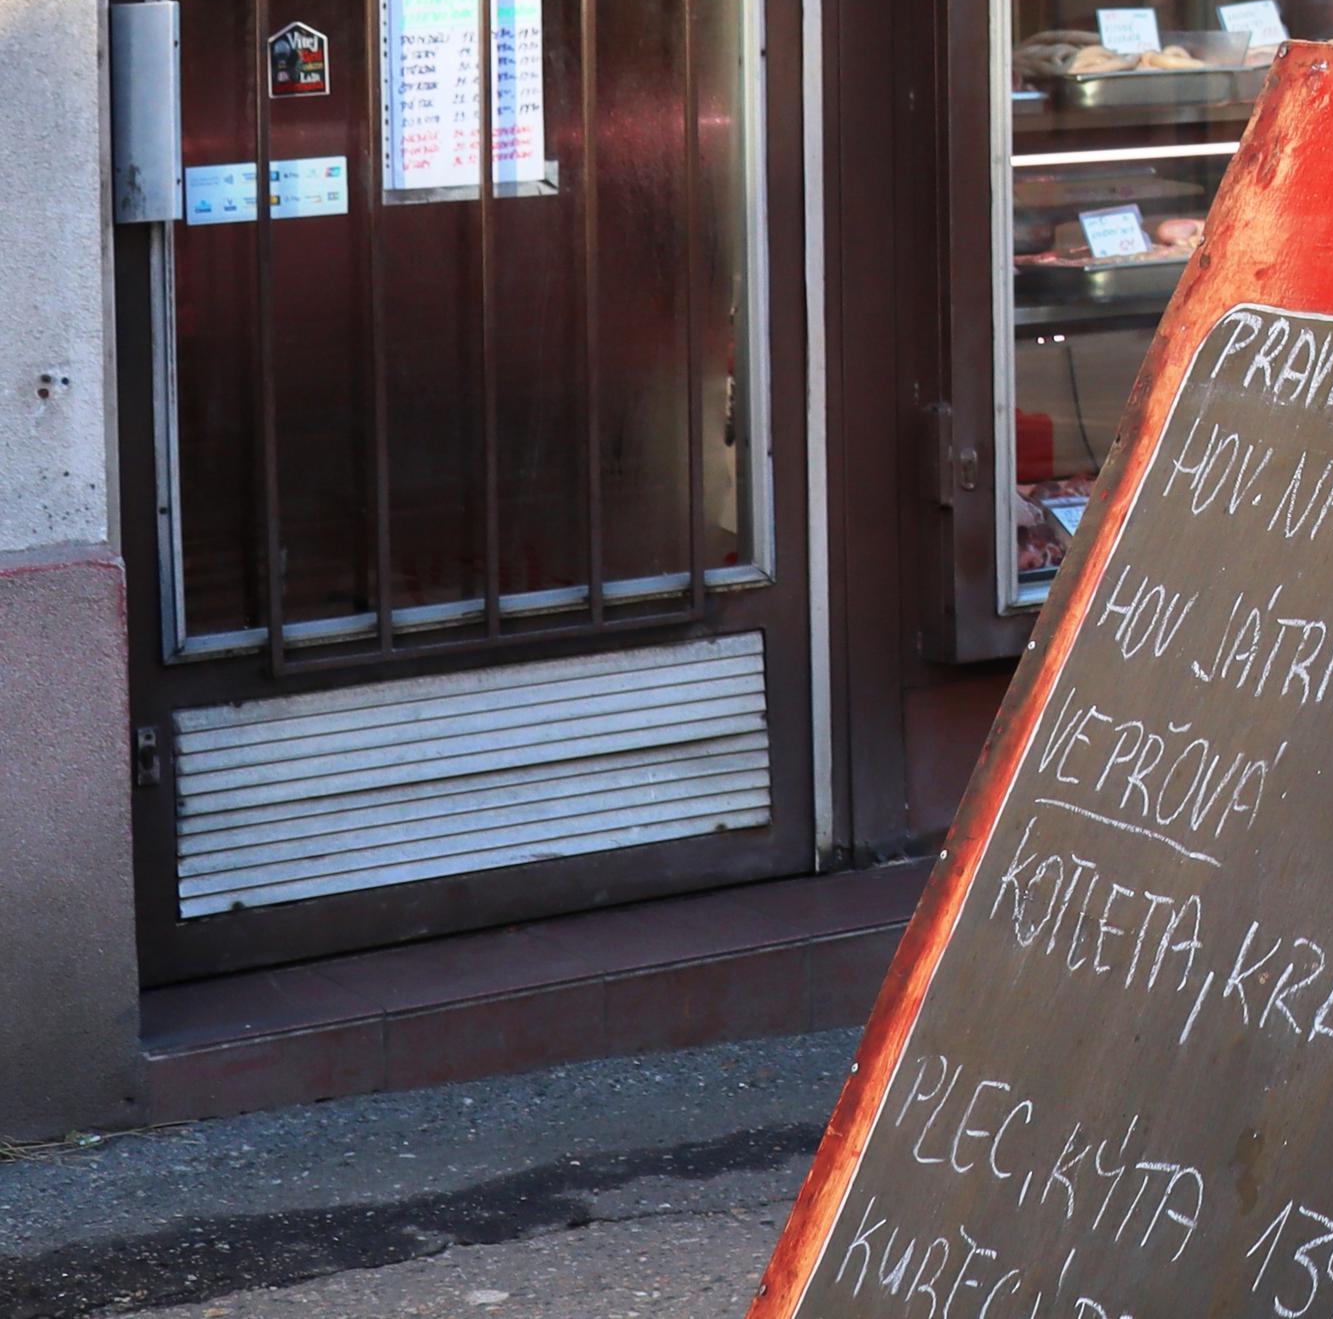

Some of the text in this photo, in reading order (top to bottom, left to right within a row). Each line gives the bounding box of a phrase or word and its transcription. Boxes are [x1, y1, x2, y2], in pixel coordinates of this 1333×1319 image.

[1163, 417, 1273, 516] HOV.
[1098, 565, 1199, 659] HOV
[1038, 687, 1288, 839] VEPŘOVÁ
[1040, 1114, 1205, 1263] KÝTA
